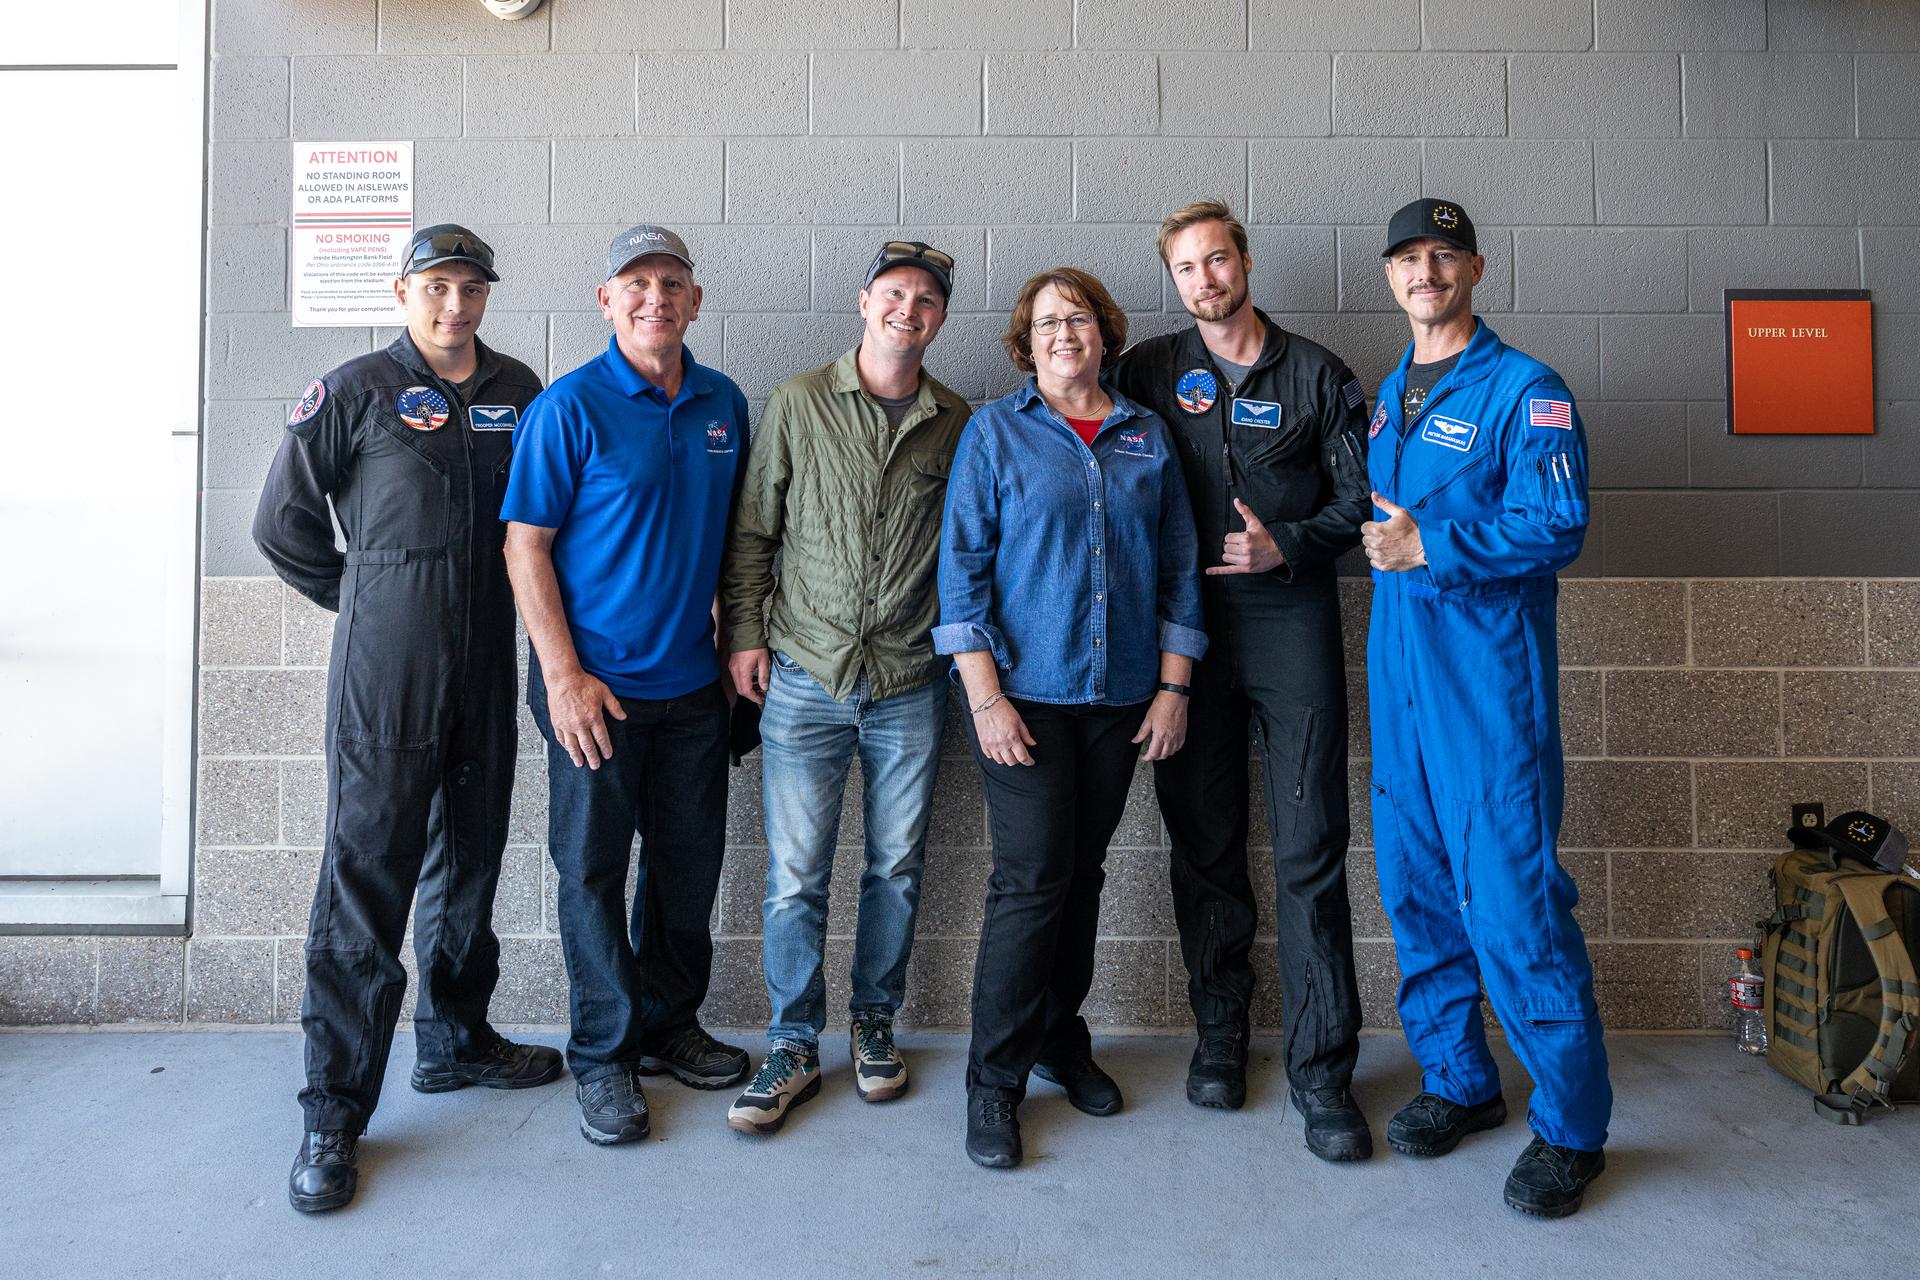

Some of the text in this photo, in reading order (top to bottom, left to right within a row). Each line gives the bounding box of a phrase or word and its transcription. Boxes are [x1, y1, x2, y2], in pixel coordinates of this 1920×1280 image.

[309, 151, 398, 164] ATTENTION
[306, 171, 401, 180] NO STANDING ROOM
[357, 183, 409, 191] AISLEWAYS
[308, 196, 322, 204] OR
[344, 195, 399, 203] PLATFORMS
[316, 234, 391, 244] NO SMOKING
[629, 232, 667, 246] NASA
[1748, 328, 1828, 338] UPPER LEVEL
